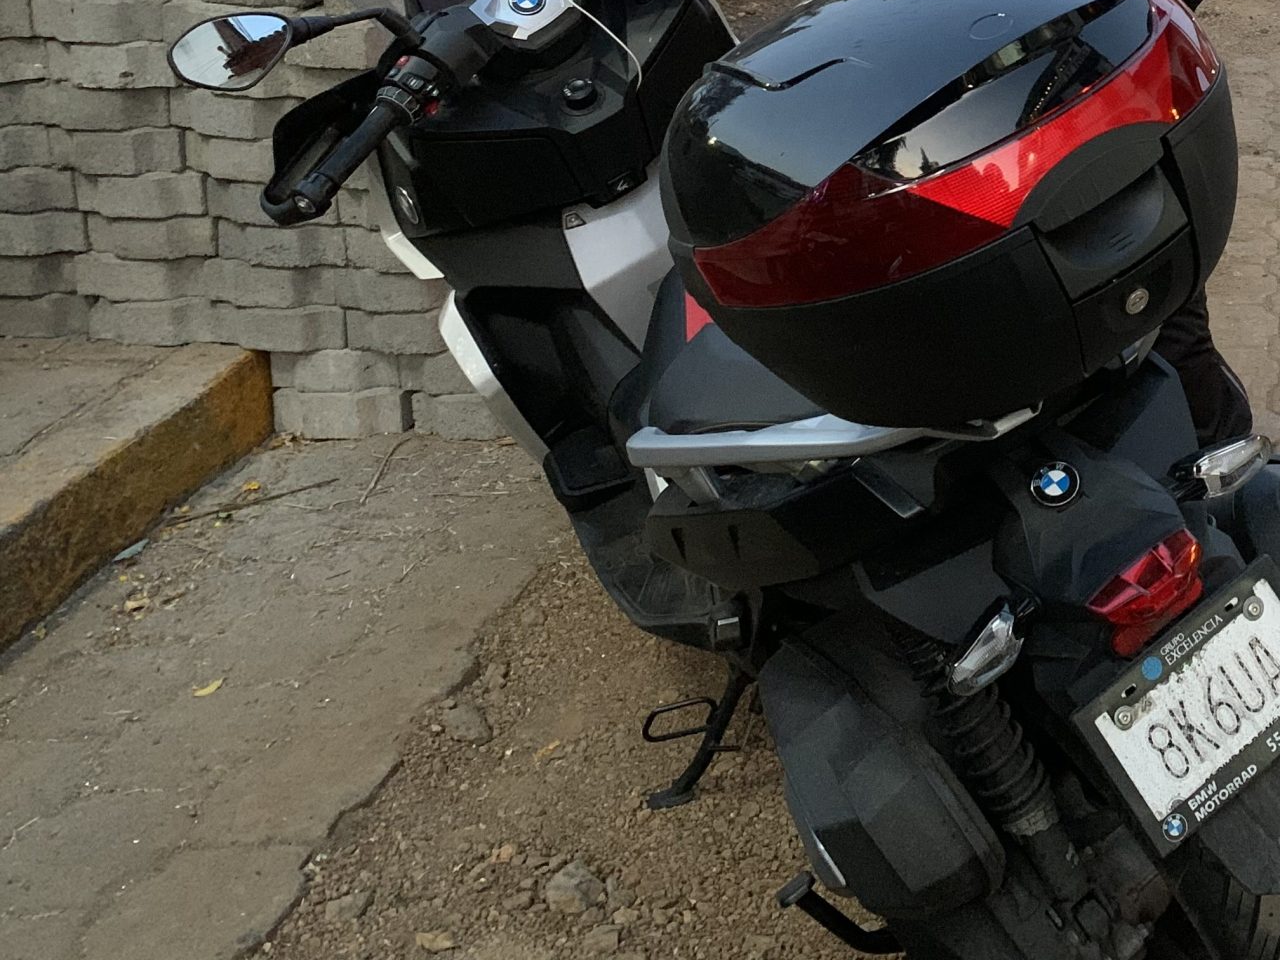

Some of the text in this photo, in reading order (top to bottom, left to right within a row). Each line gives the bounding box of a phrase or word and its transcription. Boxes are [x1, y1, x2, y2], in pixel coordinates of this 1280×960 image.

[1160, 633, 1185, 656] GRUPO
[1165, 614, 1223, 665] EXCELENCIA
[1187, 780, 1218, 811] BMW
[1194, 764, 1258, 822] MOTORRAD
